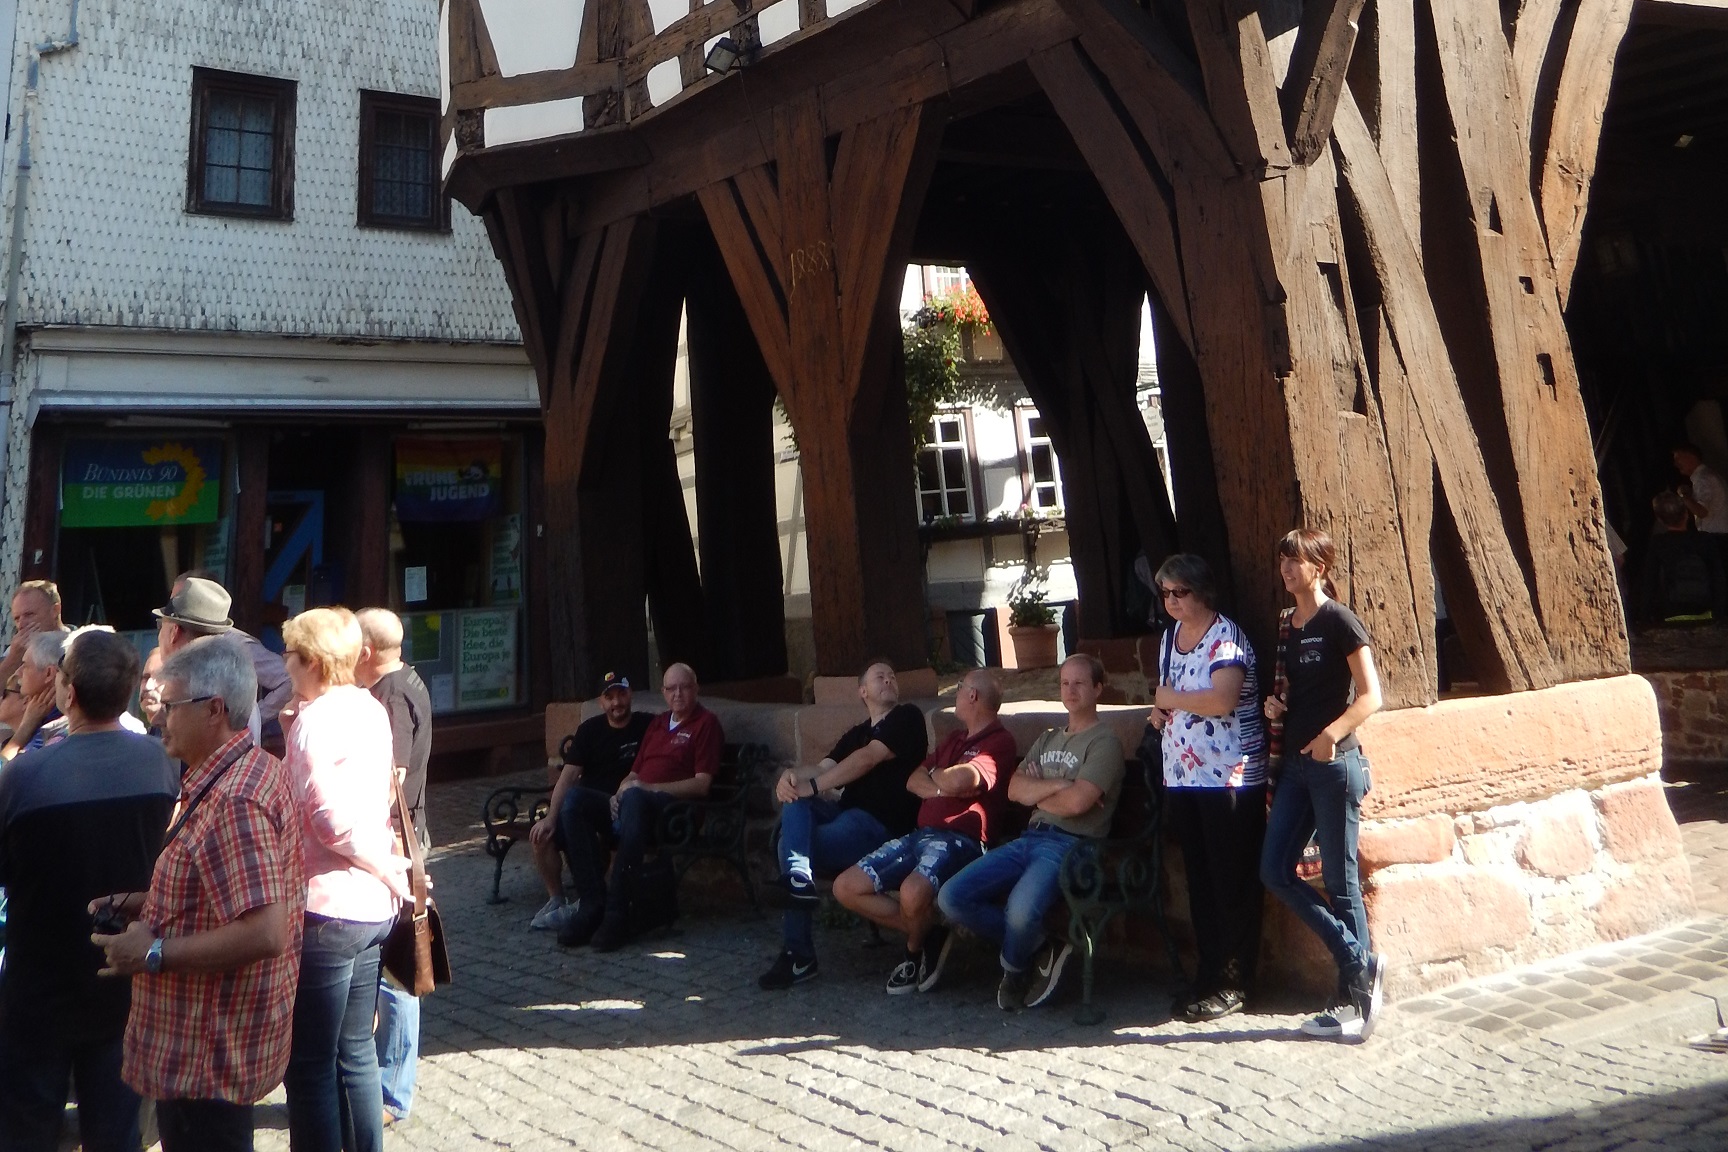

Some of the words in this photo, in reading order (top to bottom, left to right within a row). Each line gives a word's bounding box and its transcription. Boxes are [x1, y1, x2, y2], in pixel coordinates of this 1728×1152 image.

[160, 465, 179, 481] 90
[82, 486, 108, 499] DIE
[113, 483, 177, 499] GRÜNEN
[430, 483, 490, 502] JUGEND
[462, 628, 481, 639] Die
[488, 637, 504, 648] die
[462, 650, 500, 663] Europa
